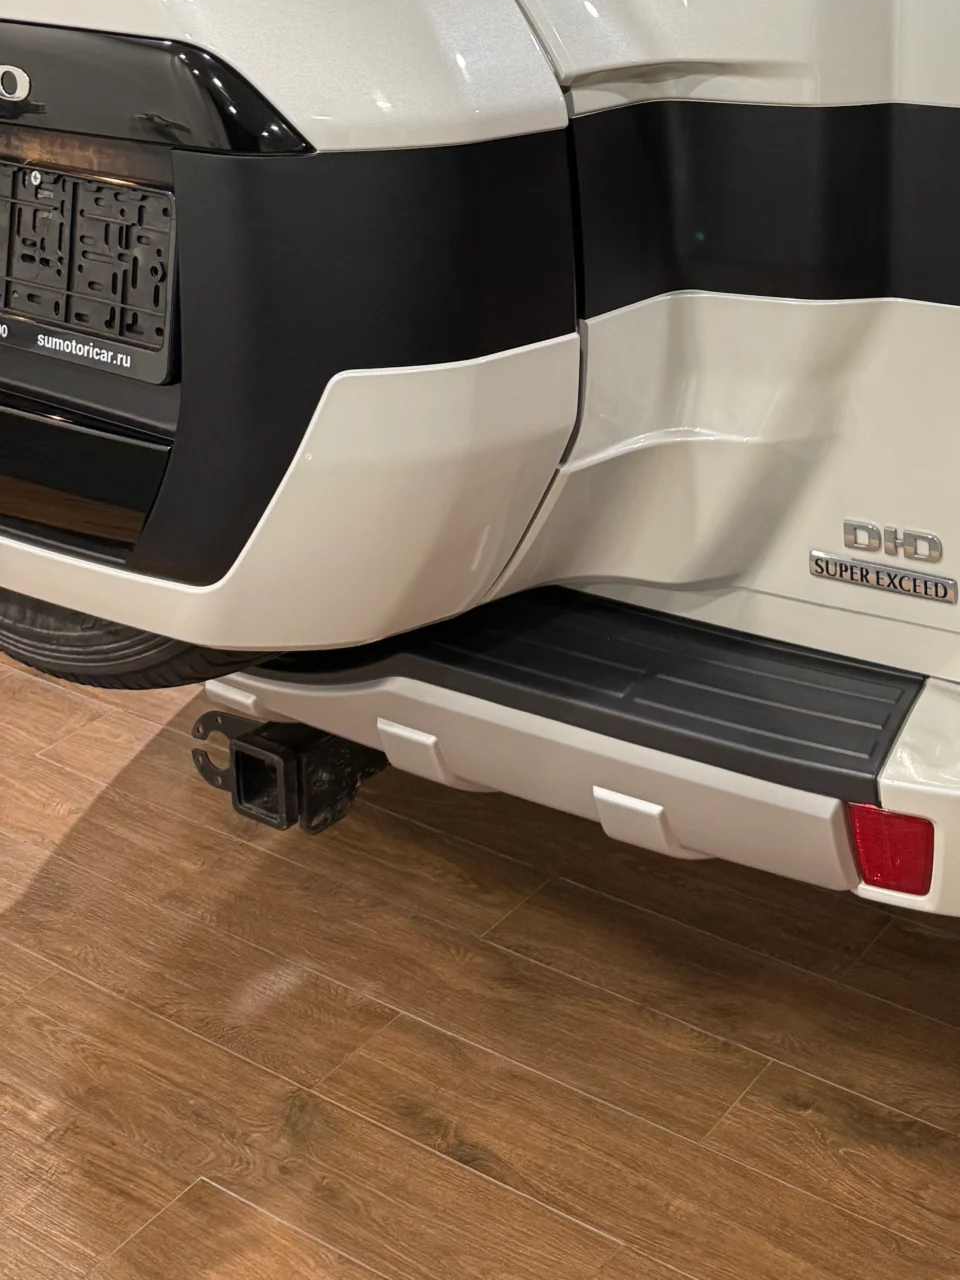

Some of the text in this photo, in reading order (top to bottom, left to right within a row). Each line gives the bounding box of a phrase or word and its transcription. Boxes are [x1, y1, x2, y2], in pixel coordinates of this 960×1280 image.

[37, 334, 131, 368] sumotoricar.ru
[814, 558, 948, 599] SUPER EXCEED
